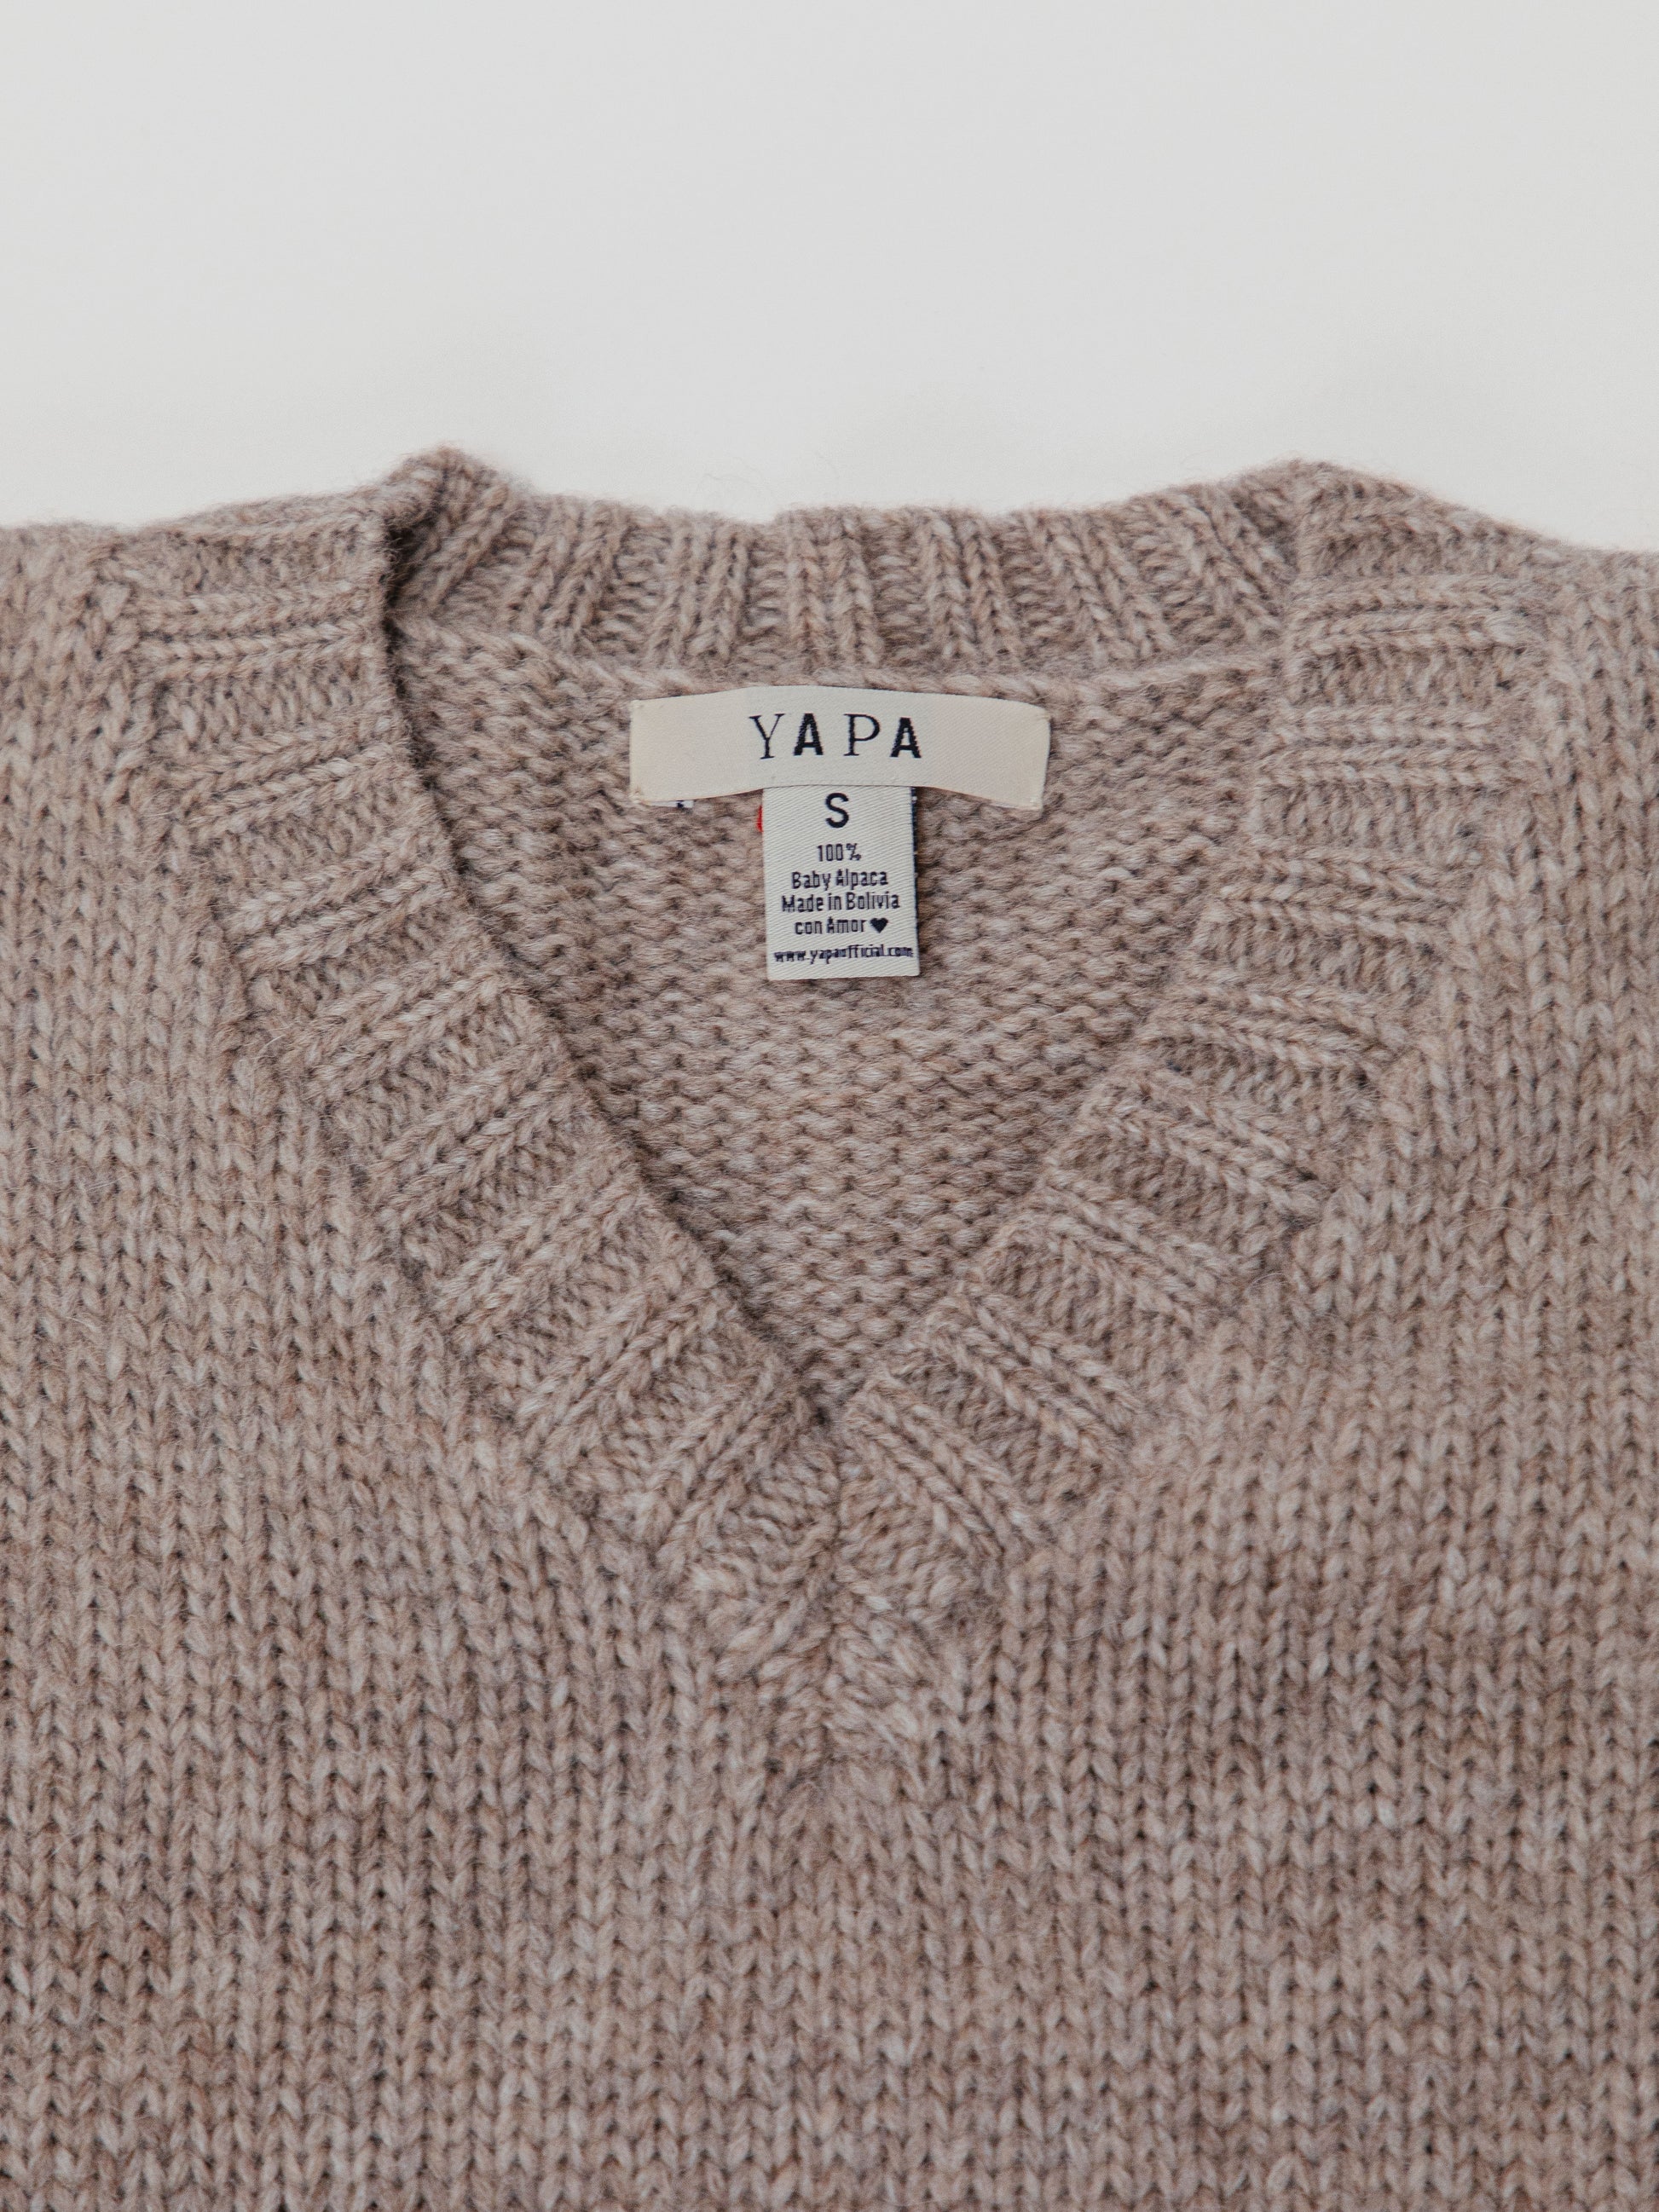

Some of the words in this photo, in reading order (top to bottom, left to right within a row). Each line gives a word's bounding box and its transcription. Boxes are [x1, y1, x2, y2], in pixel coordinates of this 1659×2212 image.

[749, 713, 922, 760] YAPA
[824, 792, 849, 829] S
[817, 842, 862, 863] 100%
[791, 869, 830, 891] Baby
[835, 868, 888, 891] Alpaca
[782, 893, 824, 913] Made
[828, 892, 841, 911] in
[846, 891, 900, 910] Bolivia
[795, 920, 823, 935] con
[826, 916, 867, 934] Amor
